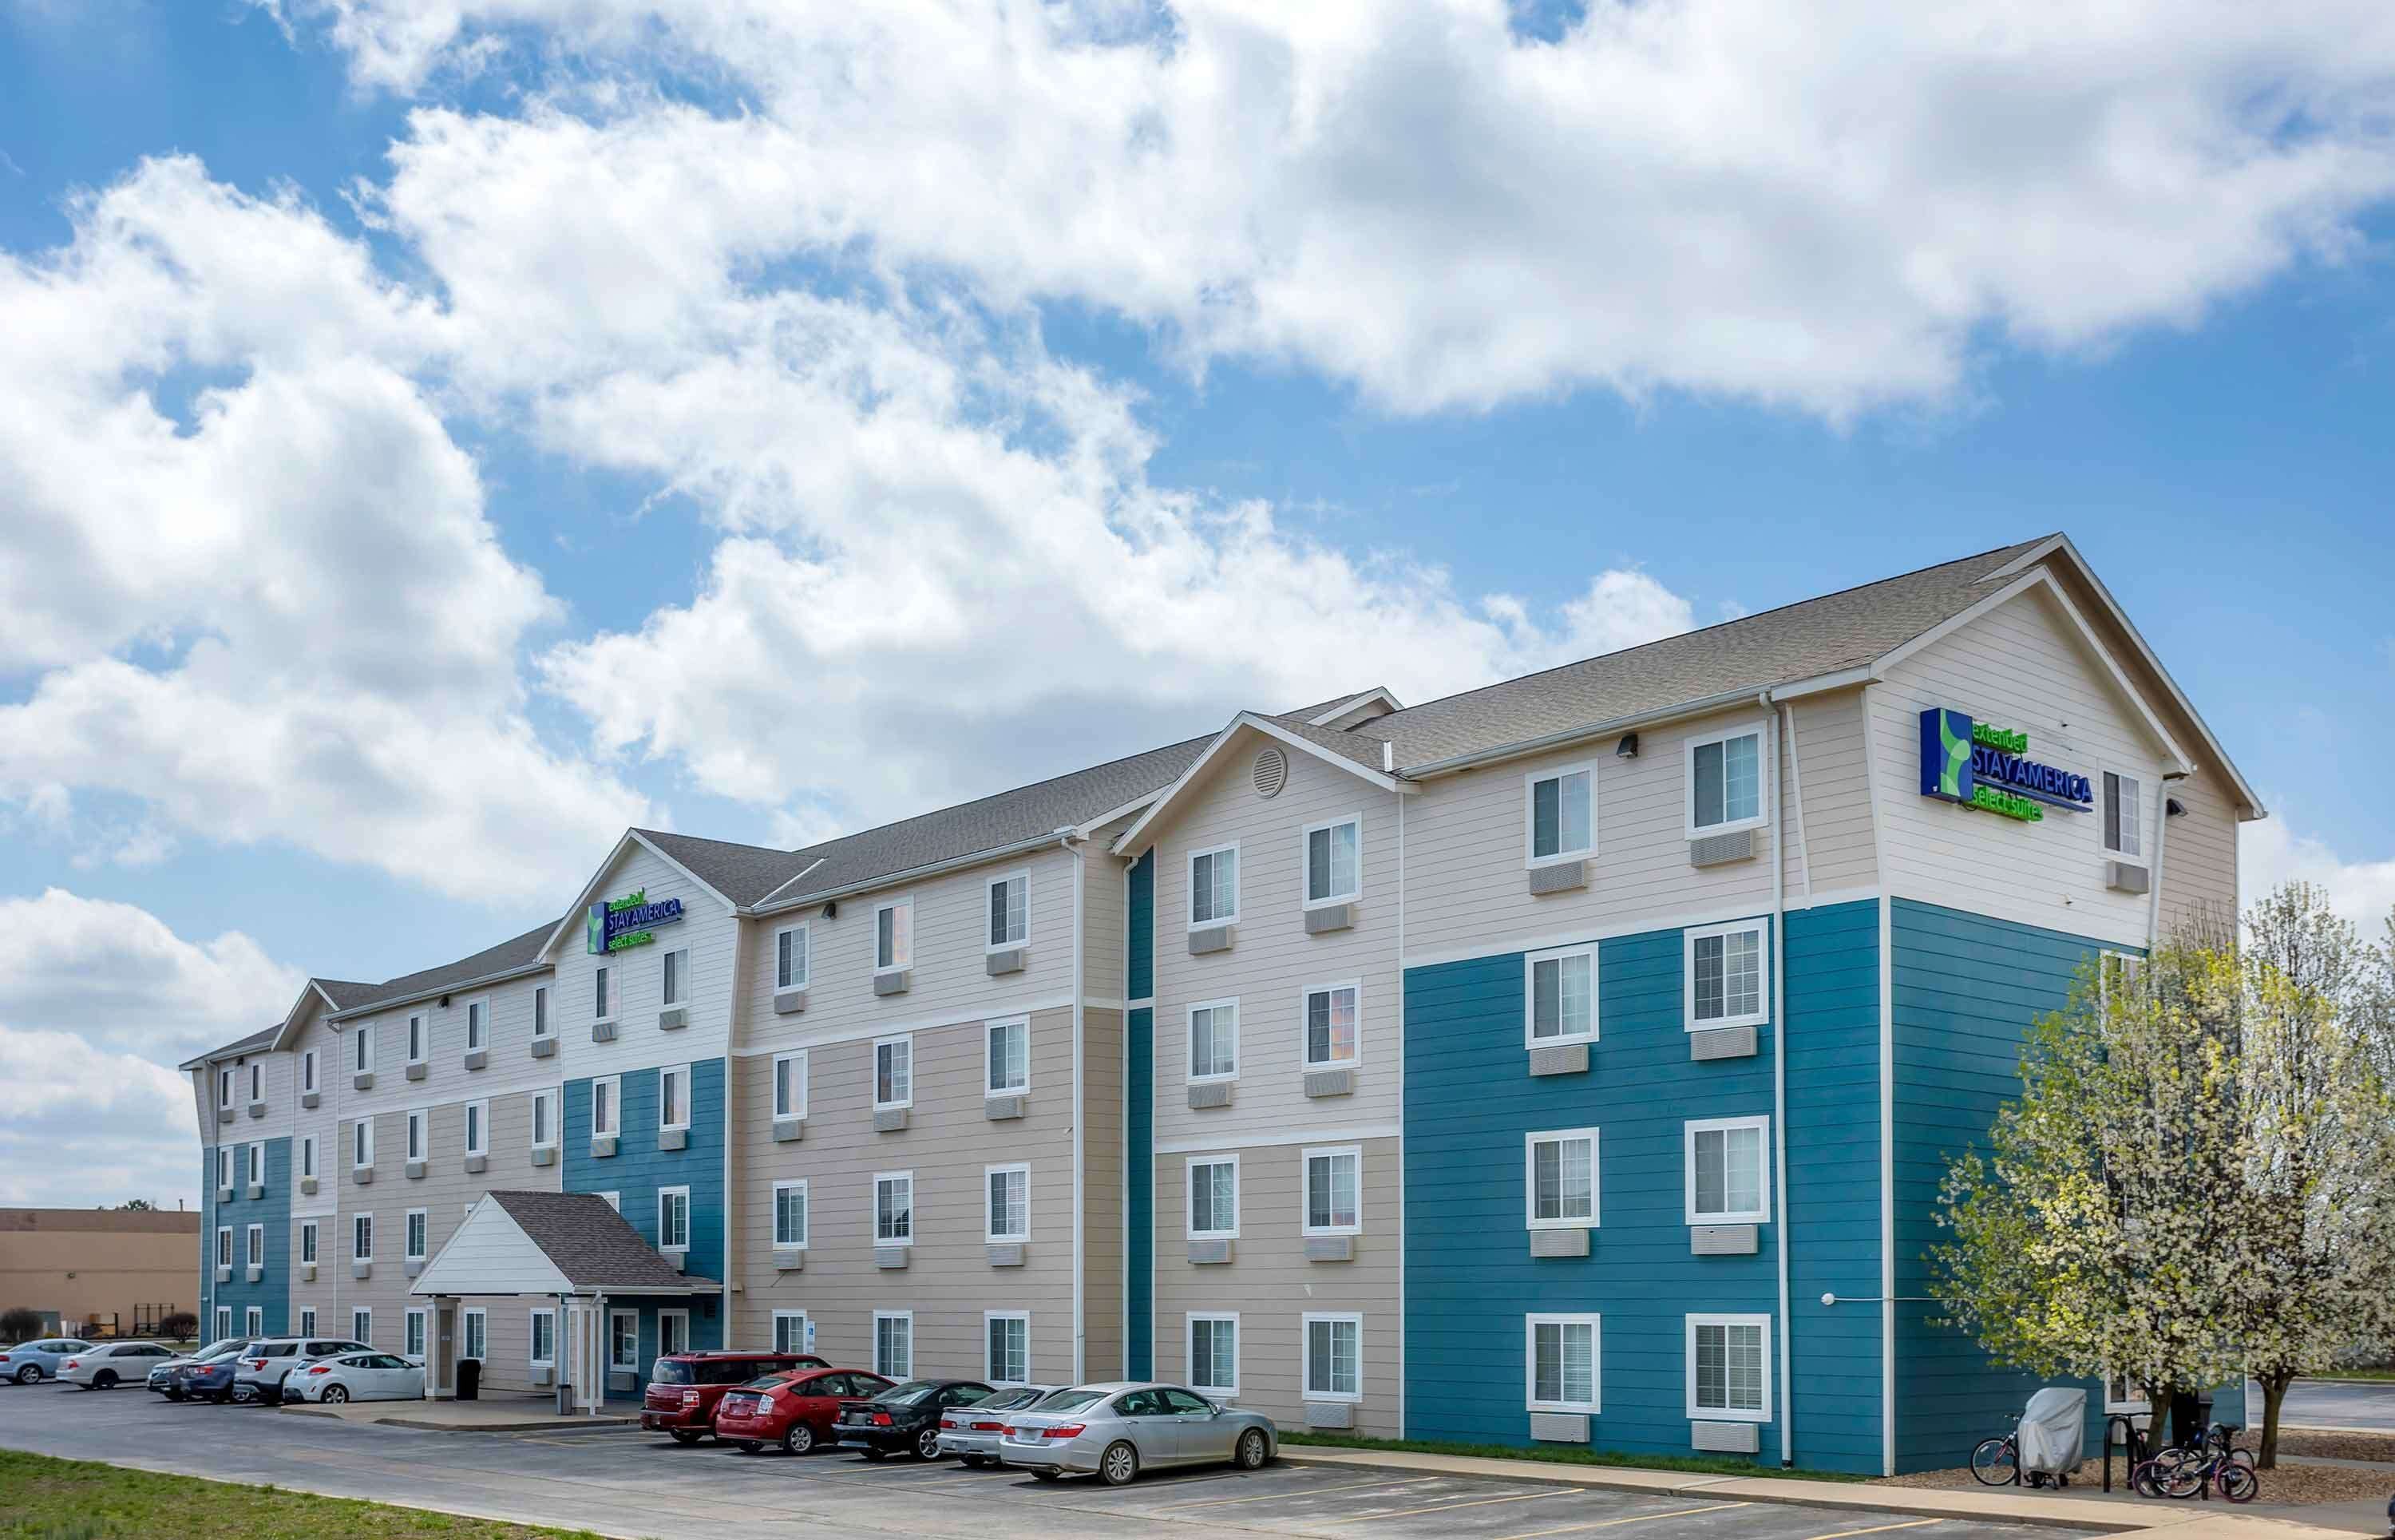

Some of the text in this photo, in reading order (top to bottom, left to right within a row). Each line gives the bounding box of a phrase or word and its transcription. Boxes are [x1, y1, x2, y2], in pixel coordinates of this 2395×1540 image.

[1973, 723, 2027, 752] extended
[1973, 745, 2093, 802] STAY AMERICA
[1973, 786, 2045, 822] select suites
[609, 891, 643, 911] extended
[609, 899, 679, 930] STAY AMERICA
[608, 932, 651, 949] select suites
